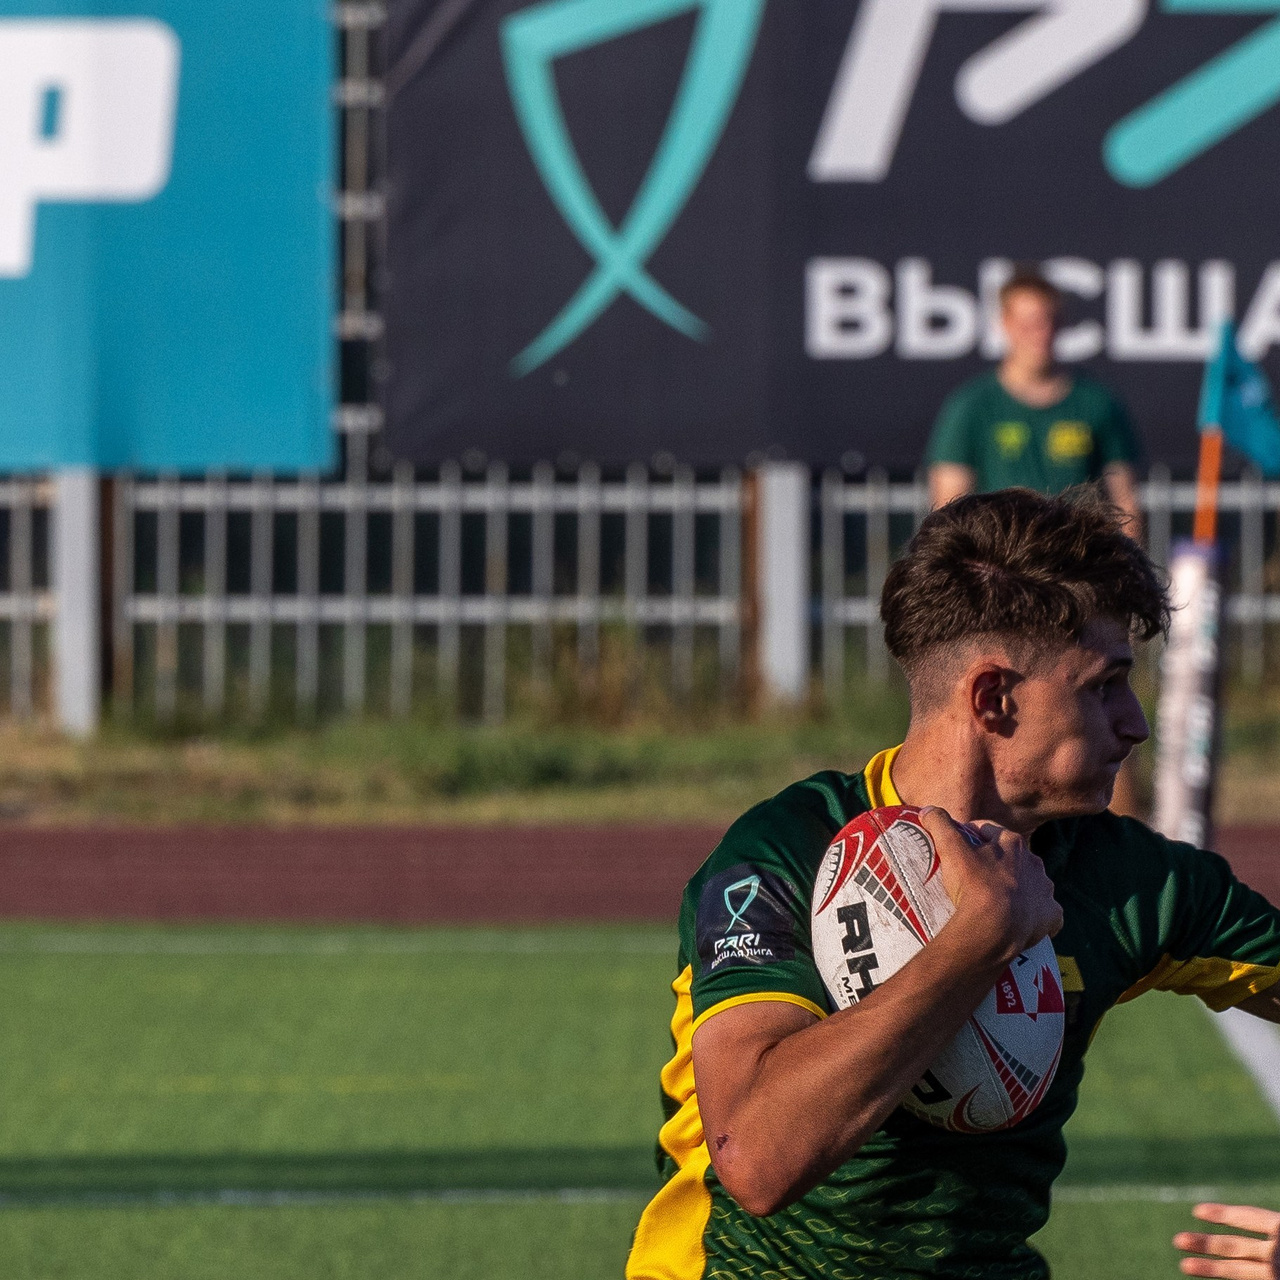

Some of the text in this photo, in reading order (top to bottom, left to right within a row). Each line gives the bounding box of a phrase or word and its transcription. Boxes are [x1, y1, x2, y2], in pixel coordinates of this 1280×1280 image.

[714, 933, 761, 955] PARI
[746, 948, 774, 957] ЛИГА
[1000, 980, 1018, 1009] 1892
